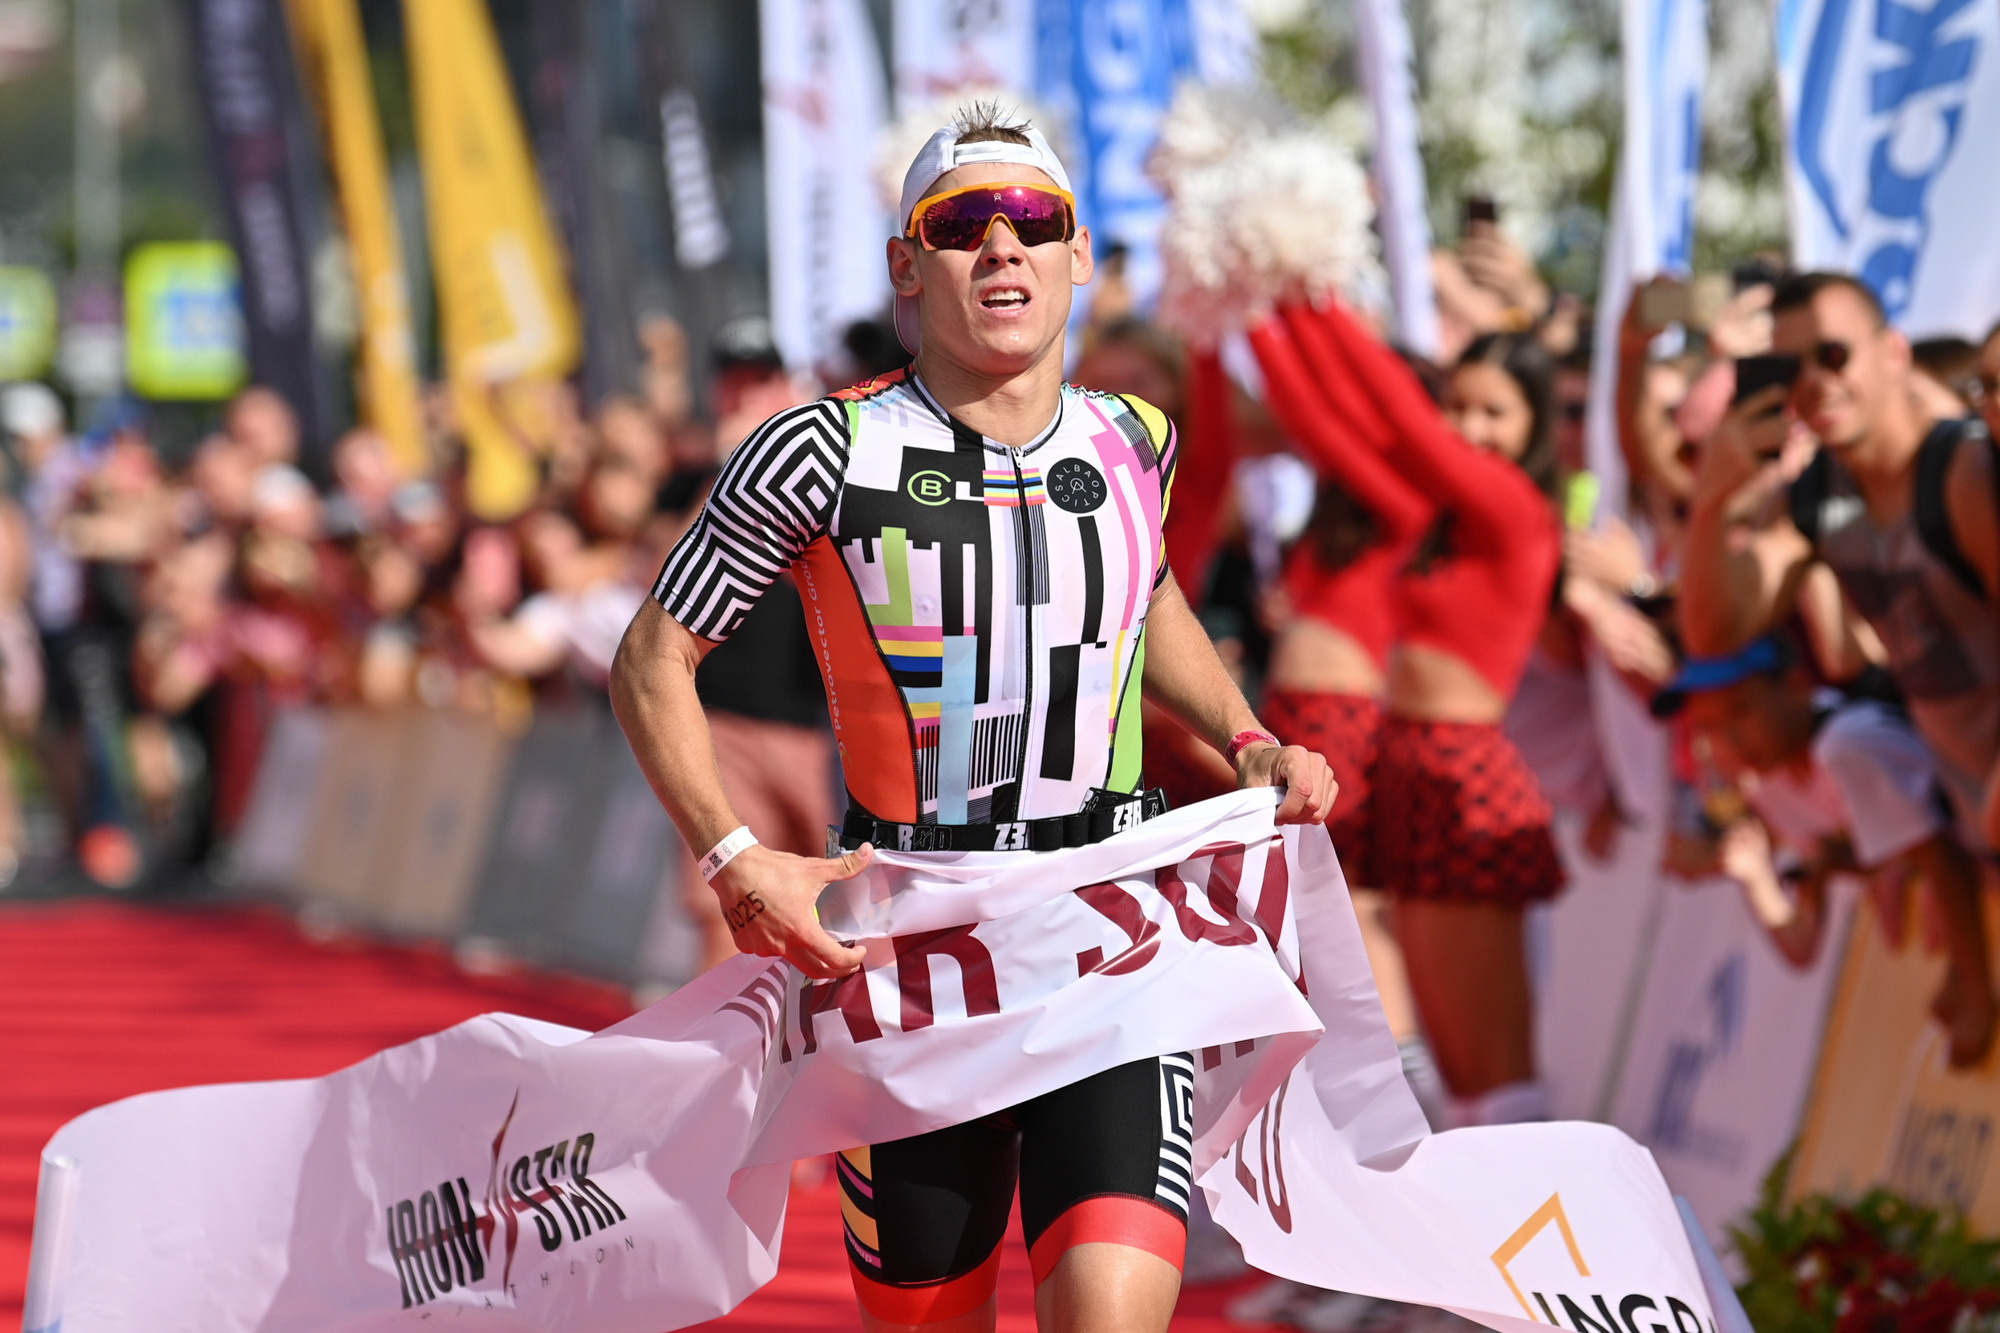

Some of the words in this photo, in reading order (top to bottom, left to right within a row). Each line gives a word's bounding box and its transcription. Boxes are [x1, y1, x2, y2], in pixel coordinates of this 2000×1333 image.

[801, 556, 819, 601] Grou
[814, 604, 842, 731] Petrovector
[992, 821, 1030, 851] Z3
[724, 890, 766, 932] 1025
